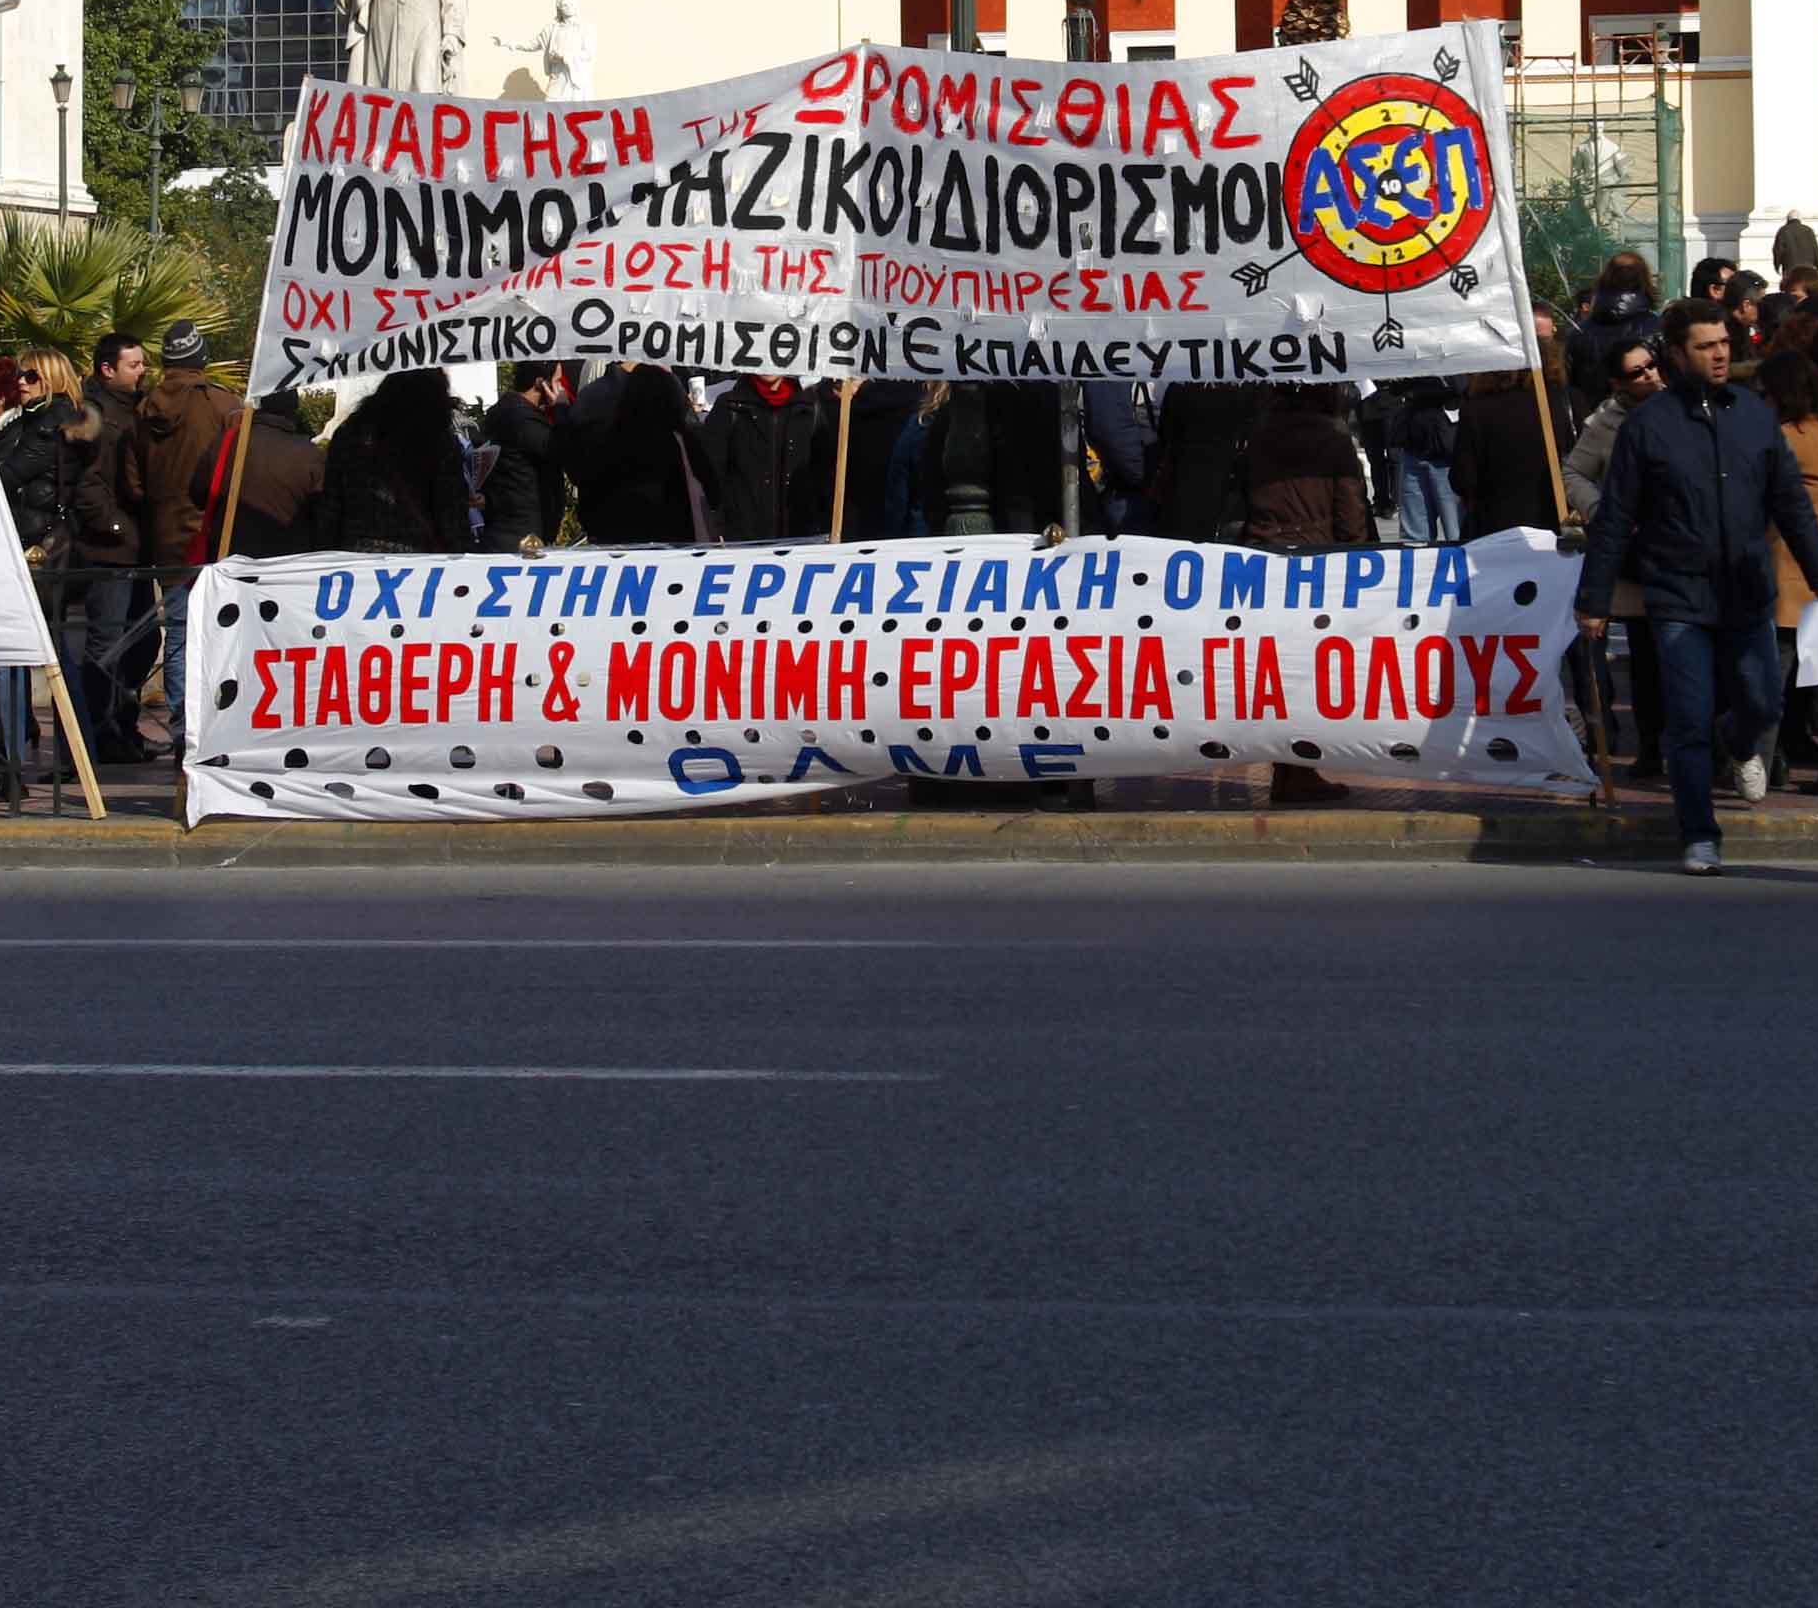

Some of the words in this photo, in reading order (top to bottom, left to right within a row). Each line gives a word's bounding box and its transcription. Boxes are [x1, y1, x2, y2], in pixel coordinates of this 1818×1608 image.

[301, 87, 655, 182] ΚΑΤΑΡΓΗΣΗ
[794, 52, 1263, 161] ΩΡΟΜΙΣΘΙΑΣ
[928, 147, 1284, 259] ΔΙΟΡΙΣΜΟΙ
[1298, 127, 1484, 234] ΑΣΕΠ
[1381, 180, 1402, 195] 10
[282, 279, 350, 333] ΟΧΙ
[754, 245, 845, 294] ΤΗΣ
[572, 297, 886, 374] ΩΡΟΜΙΣΘΙΩΝ
[904, 317, 1347, 380] ΕΚΠΑΙΔΕΥΤΙΚΩΝ
[314, 568, 445, 620] ΟΧΙ
[477, 565, 656, 618] ΣΤΗΝ
[693, 550, 1121, 617] ΕΡΓΑΣΙΑΚΗ
[1163, 546, 1472, 610] ΟΜΗΡΙΑ
[251, 643, 517, 729] ΣΤΑΘΕΡΗ
[543, 641, 580, 722] &
[606, 639, 868, 722] ΜΟΝΙΜΗ
[898, 635, 1174, 720] ΕΡΓΑΣΙΑ
[1201, 636, 1286, 720] ΓΙΑ
[1313, 634, 1542, 721] ΟΛΟΥΣ
